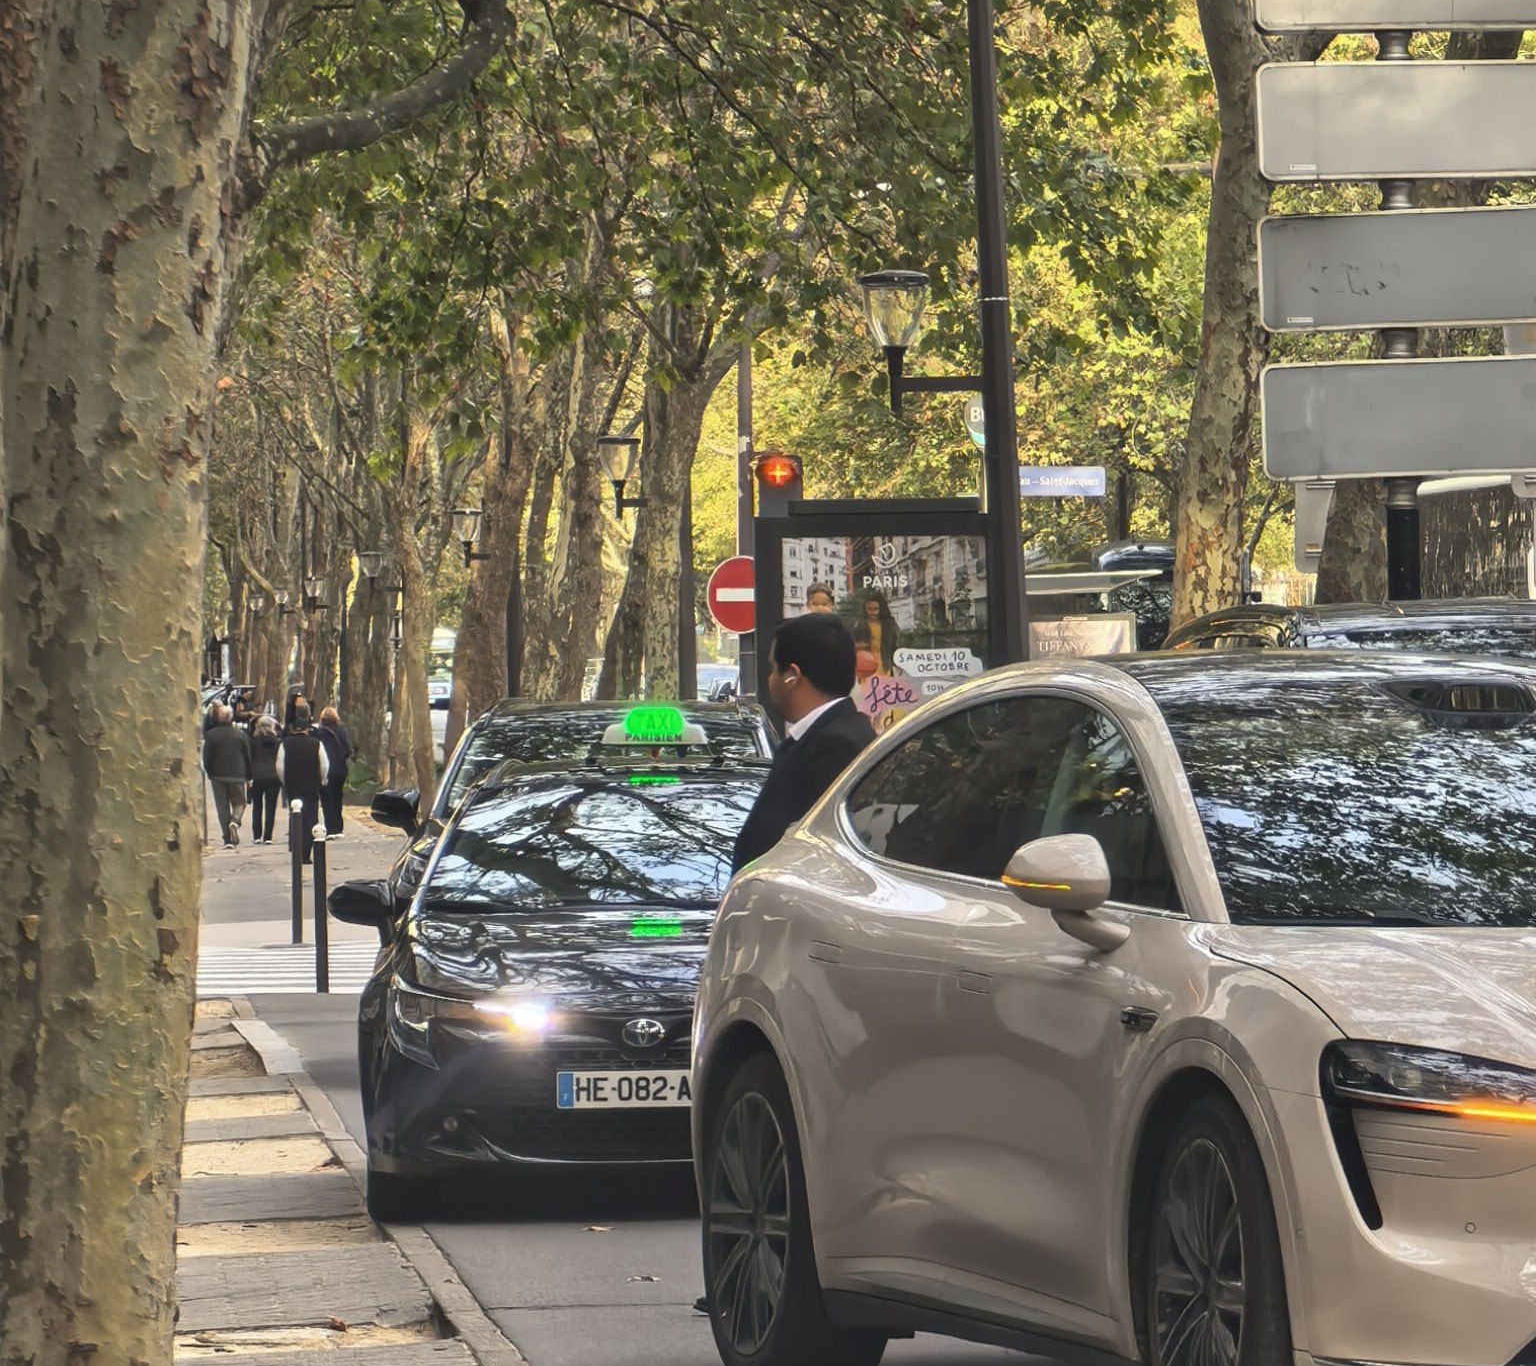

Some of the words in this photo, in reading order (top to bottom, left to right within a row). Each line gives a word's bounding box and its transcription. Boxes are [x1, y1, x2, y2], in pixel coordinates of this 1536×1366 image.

[1039, 476, 1099, 488] Saint-Jacques
[863, 575, 908, 589] PARIS
[899, 652, 947, 663] SAMEDI
[951, 651, 965, 662] 10
[917, 662, 969, 673] OCTOBRE
[865, 676, 918, 713] fête
[635, 713, 675, 731] TAXI
[625, 733, 682, 742] PARISIEN
[575, 1075, 692, 1102] HE-082-A
